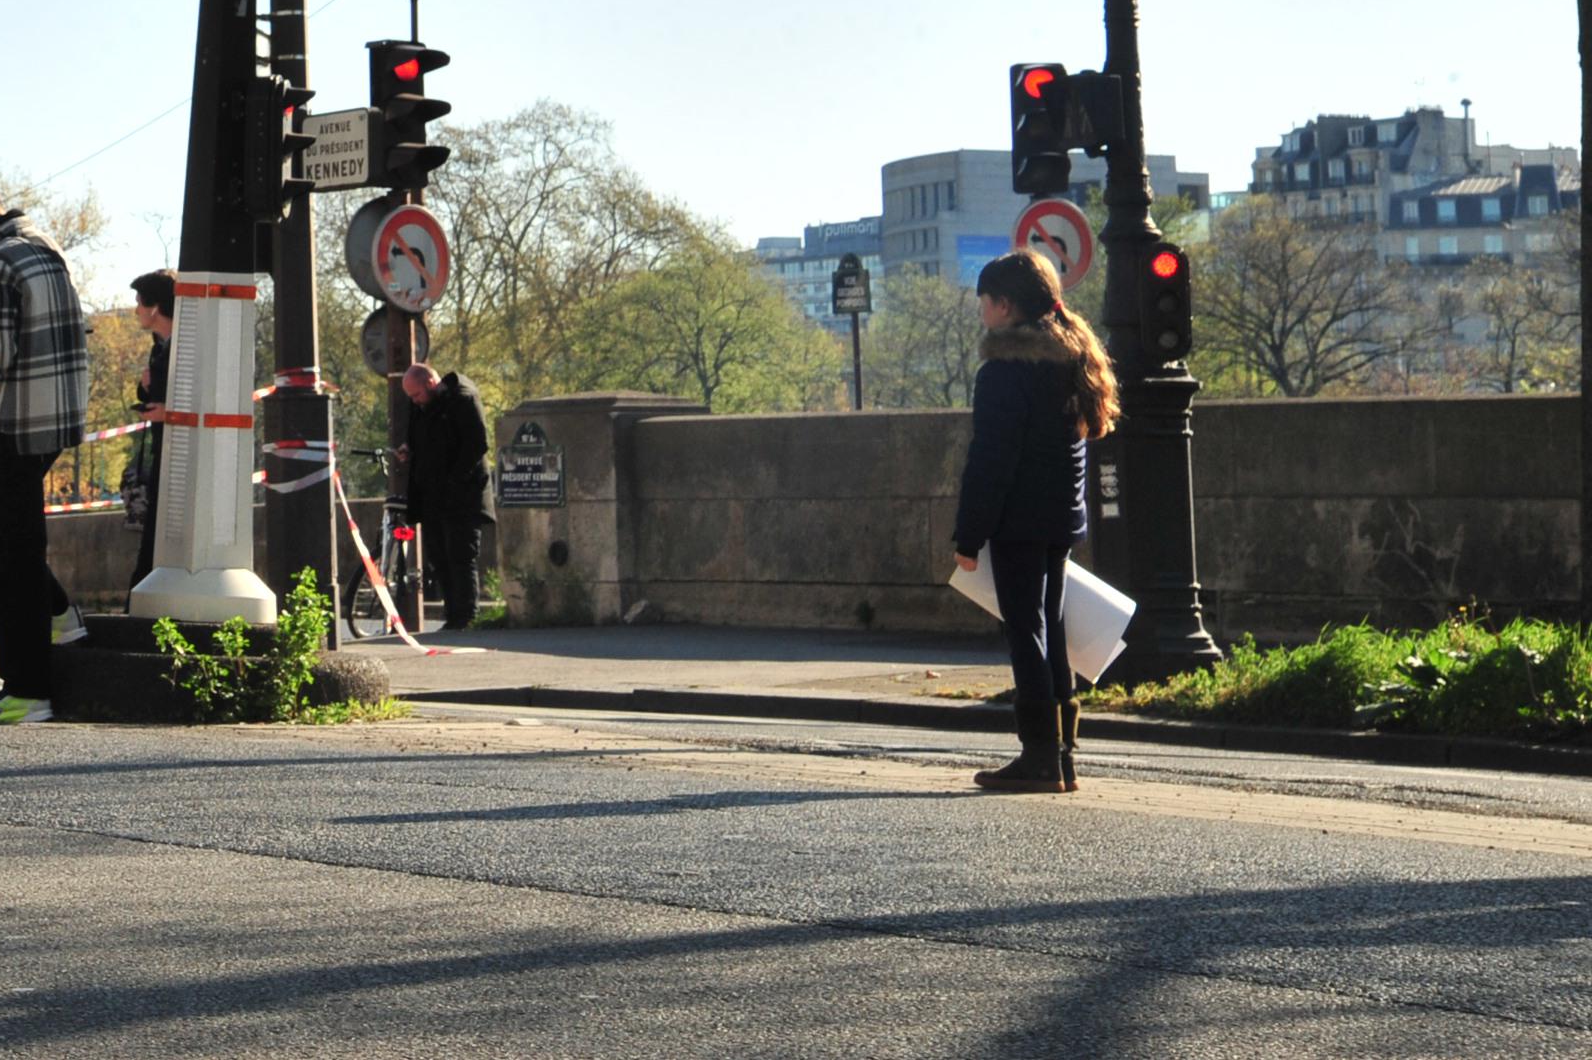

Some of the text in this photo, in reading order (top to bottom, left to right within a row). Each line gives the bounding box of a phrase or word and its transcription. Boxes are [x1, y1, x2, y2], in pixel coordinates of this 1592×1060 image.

[320, 121, 351, 134] AVENUE
[306, 139, 364, 157] DU PRÉSIDENT
[306, 158, 364, 180] KENNEDY
